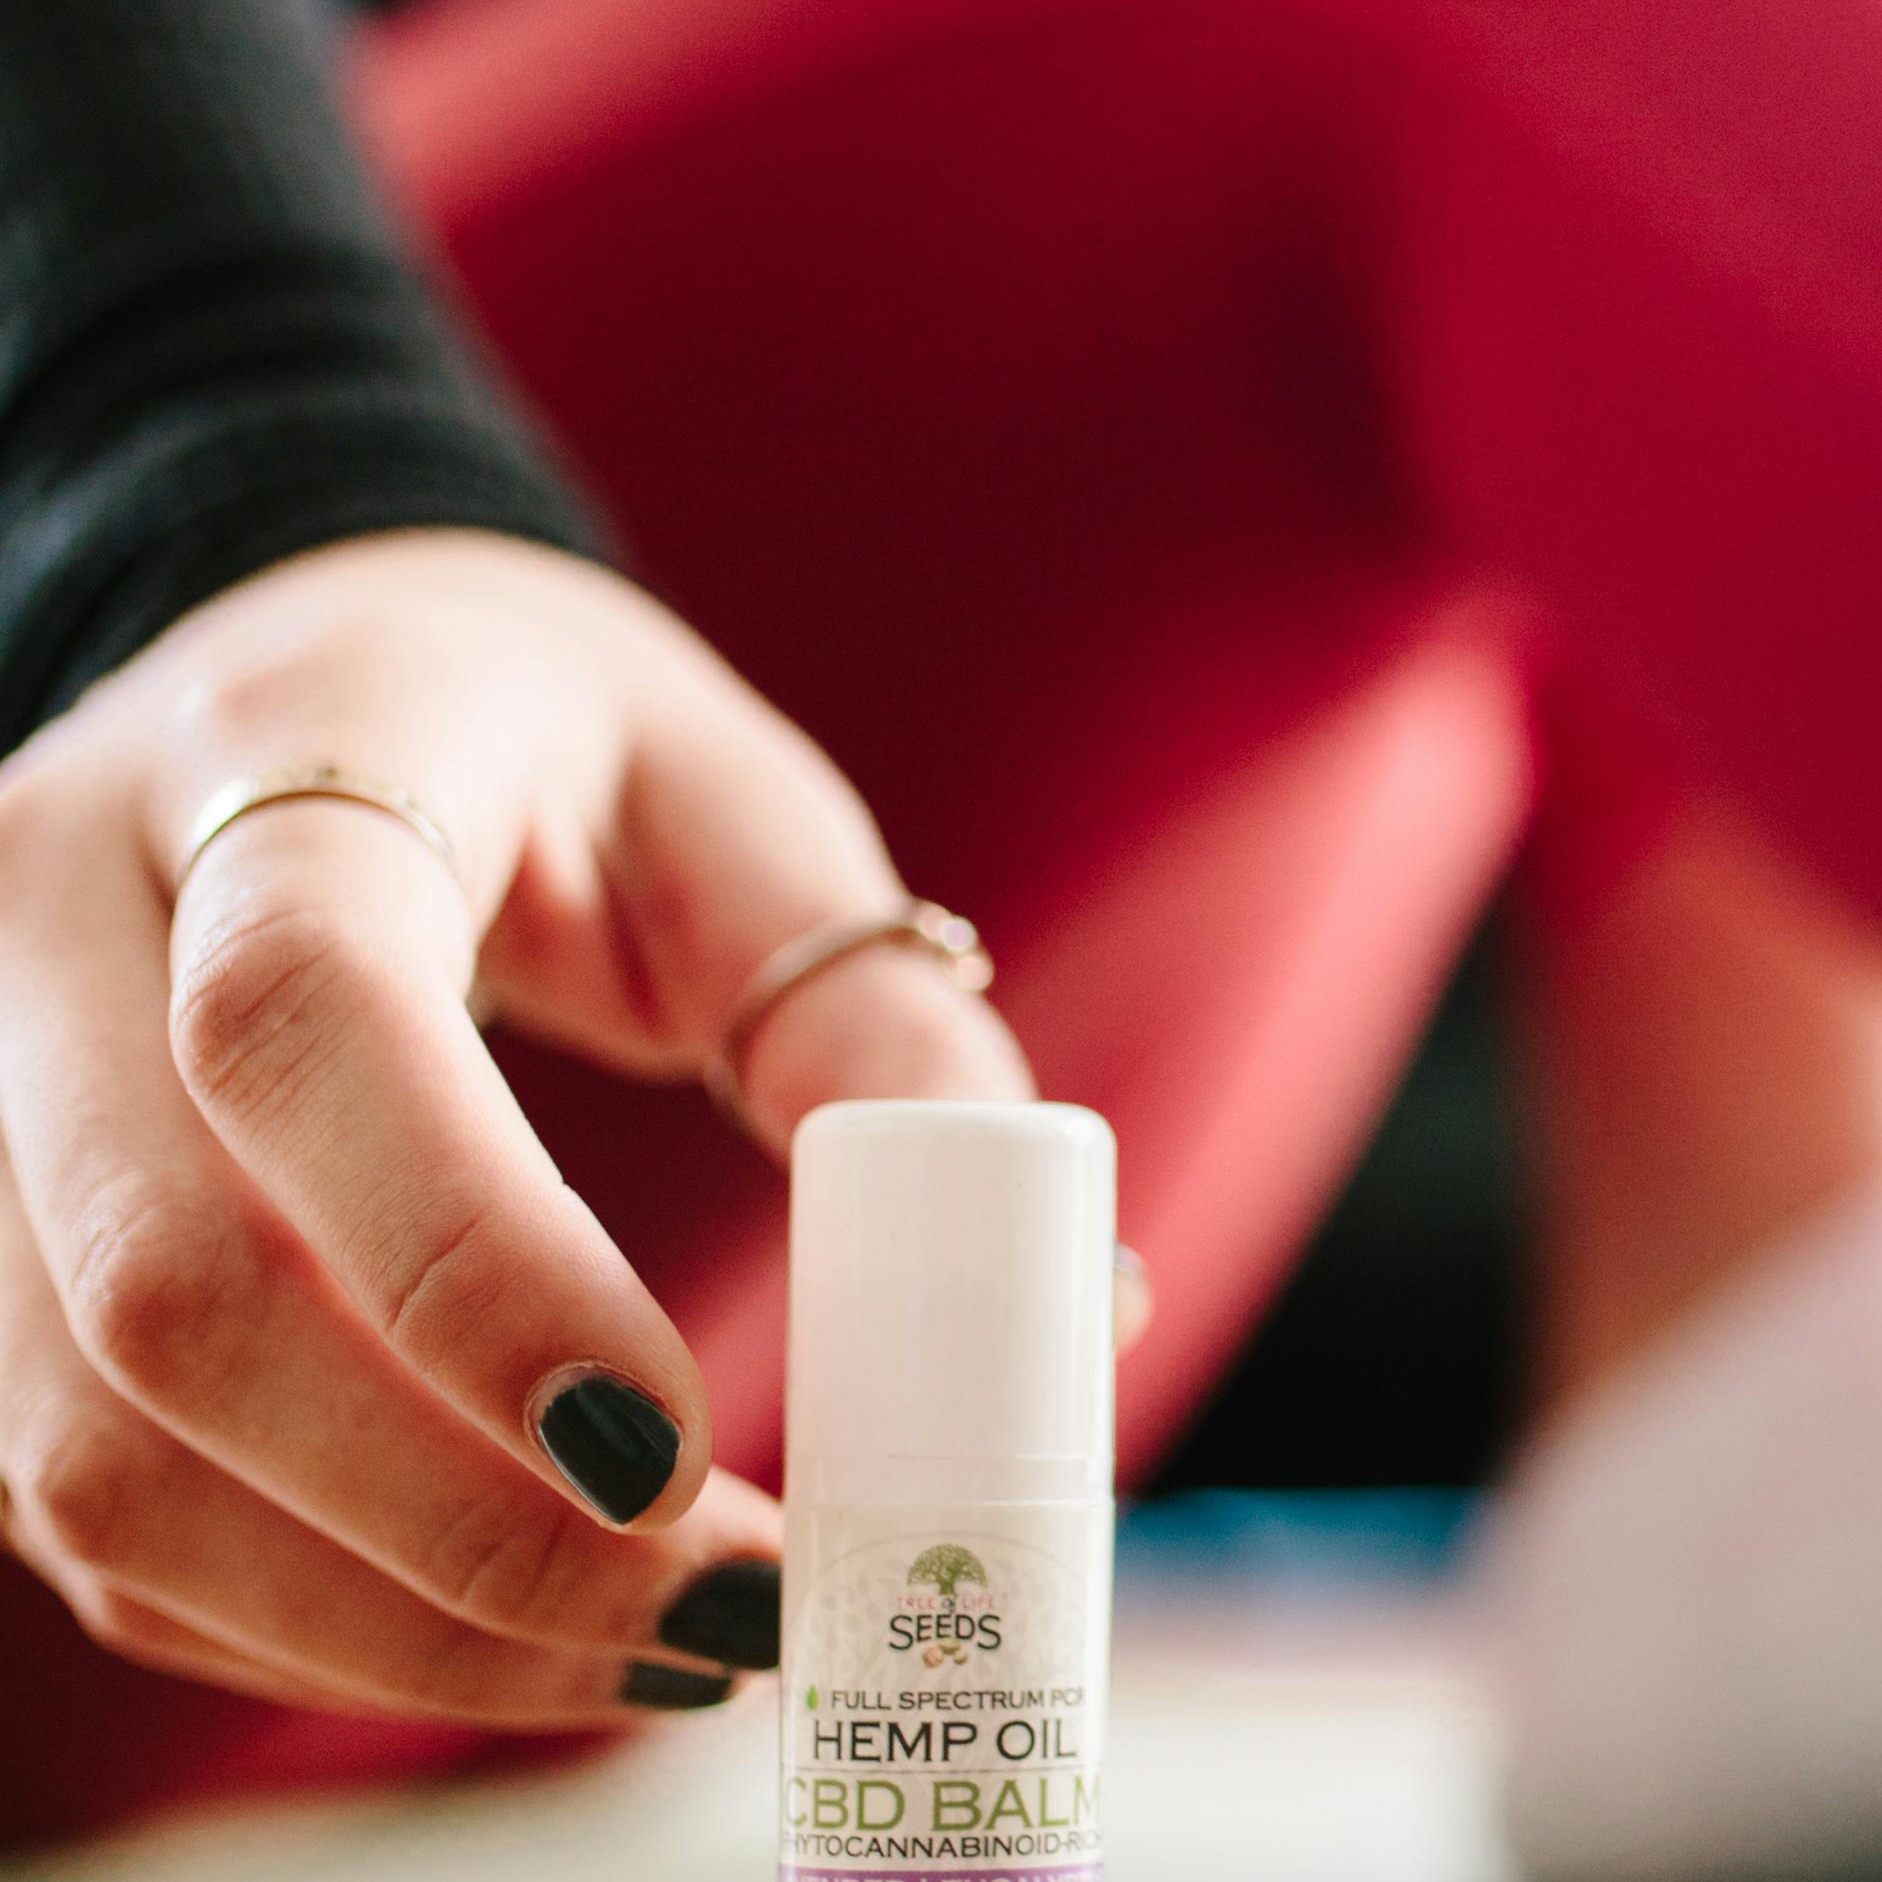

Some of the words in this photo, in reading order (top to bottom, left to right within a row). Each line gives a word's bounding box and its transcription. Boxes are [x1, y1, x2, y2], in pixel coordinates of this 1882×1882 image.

[889, 1614, 1001, 1651] SEEDS
[831, 1690, 891, 1711] FULL
[899, 1689, 1044, 1711] SPECTRUM
[814, 1719, 977, 1762] HEMP
[996, 1718, 1078, 1760] OIL
[785, 1778, 905, 1831] CBD
[930, 1774, 1100, 1831] BALM
